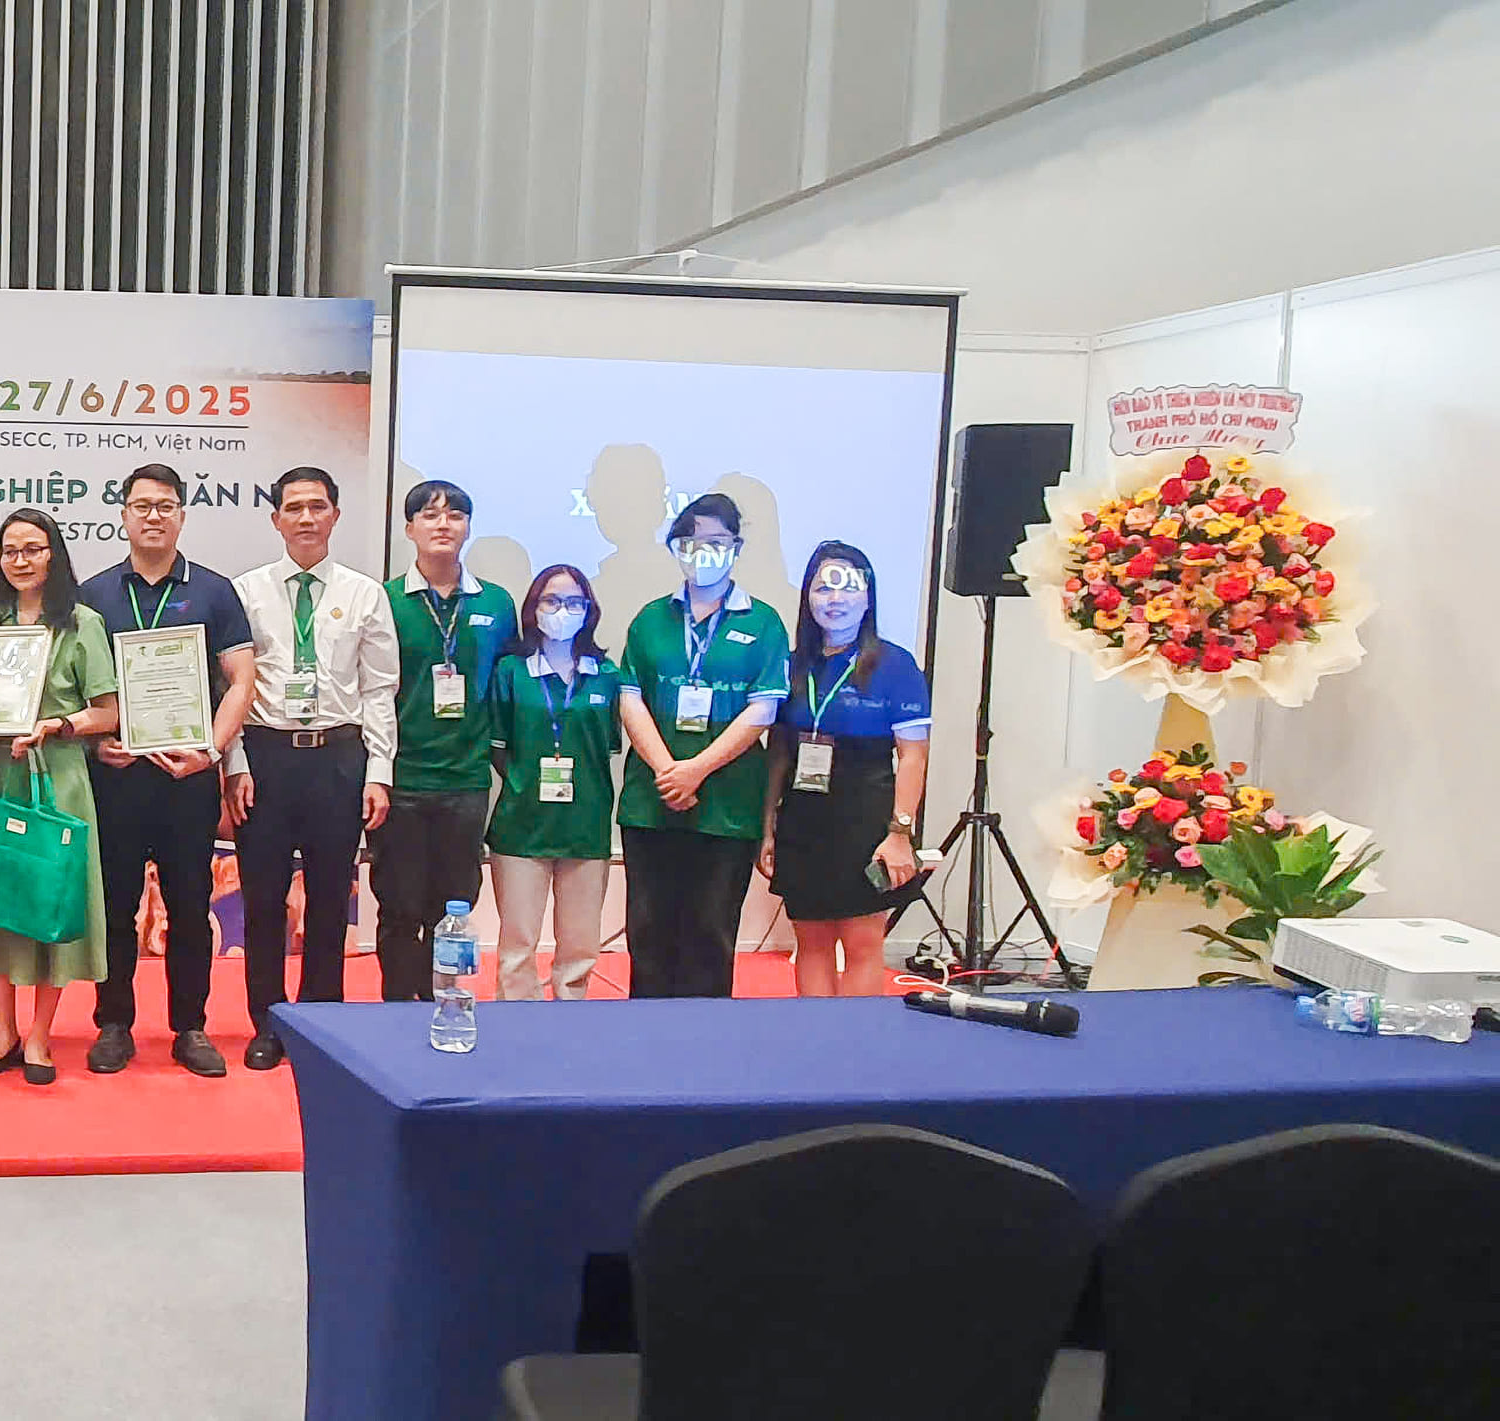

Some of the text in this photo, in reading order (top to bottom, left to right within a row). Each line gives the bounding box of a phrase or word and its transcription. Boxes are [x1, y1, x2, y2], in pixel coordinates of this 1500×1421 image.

[0, 432, 56, 450] SECC,
[64, 433, 89, 449] TP.
[98, 434, 148, 452] HCM,
[154, 434, 192, 455] Việt
[199, 436, 246, 452] Nam
